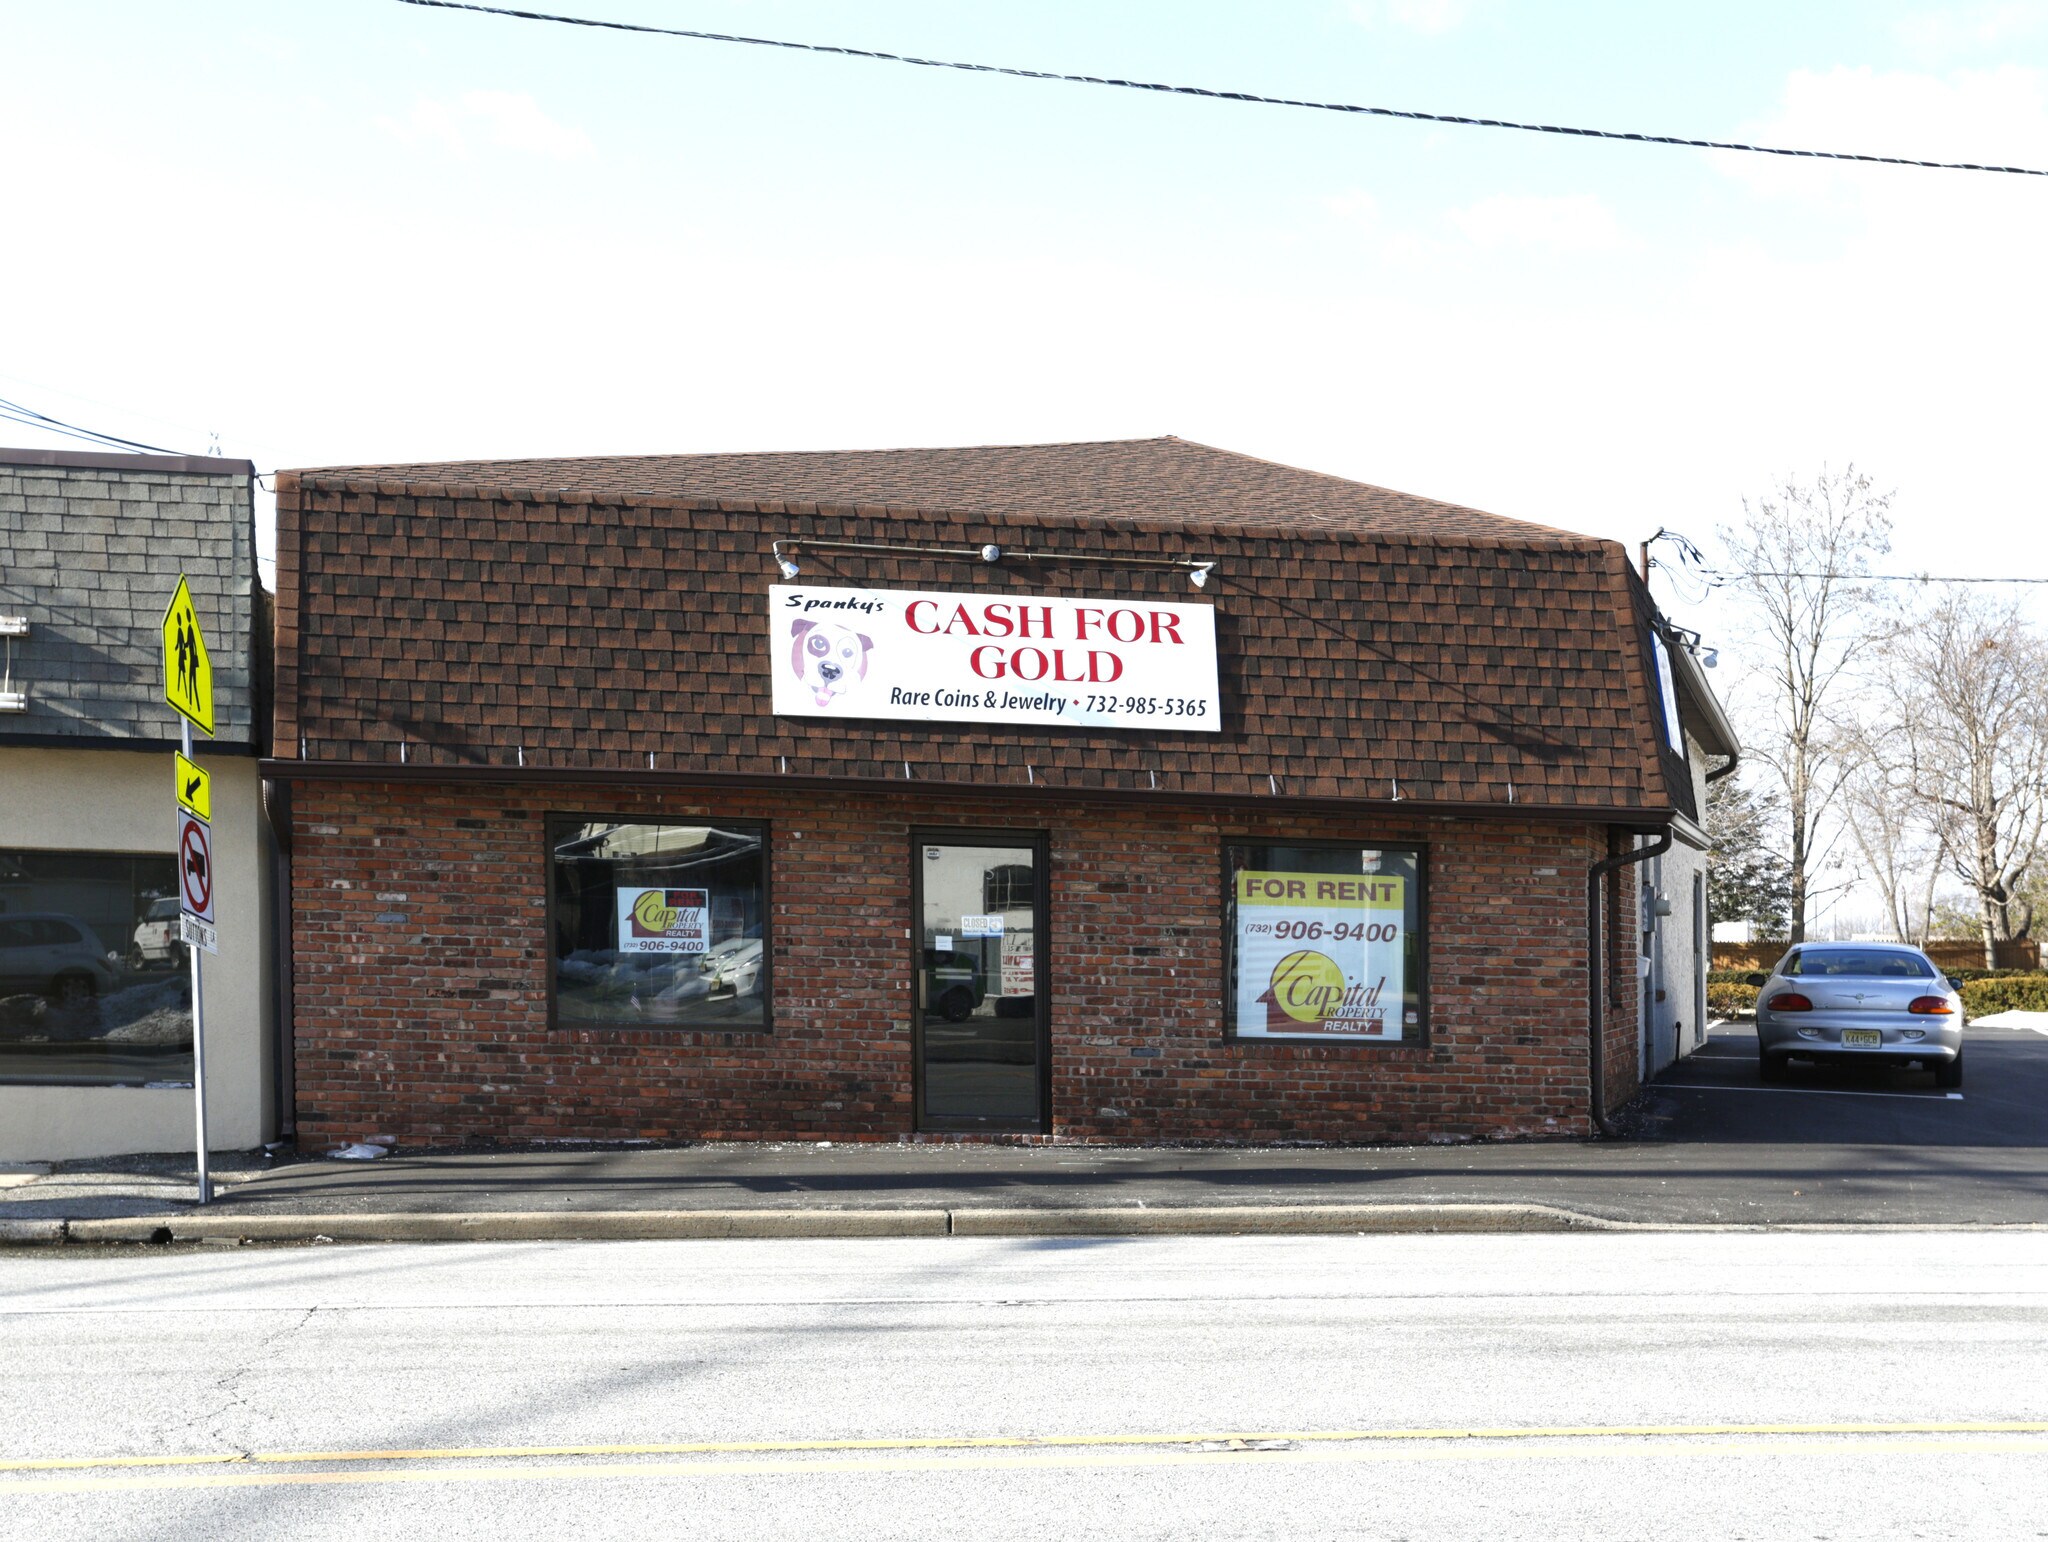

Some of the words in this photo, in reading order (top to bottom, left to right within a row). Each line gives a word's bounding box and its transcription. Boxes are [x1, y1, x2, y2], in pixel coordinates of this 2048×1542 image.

[785, 594, 884, 614] Spanky's
[904, 600, 1055, 639] CASH
[1075, 608, 1185, 645] FOR
[969, 645, 1124, 683] GOLD
[890, 687, 930, 706] Rare
[934, 689, 979, 708] Coins
[985, 691, 997, 709] &
[1000, 692, 1067, 716] Jewelry
[1085, 695, 1207, 717] 732-985-5365
[1246, 879, 1306, 899] FOR
[1317, 881, 1397, 901] RENT
[963, 917, 988, 928] CLOSED
[1245, 923, 1272, 935] (732)
[1274, 920, 1398, 942] 906-9400
[639, 941, 704, 951] 906-9400
[1324, 1021, 1373, 1032] REALTY
